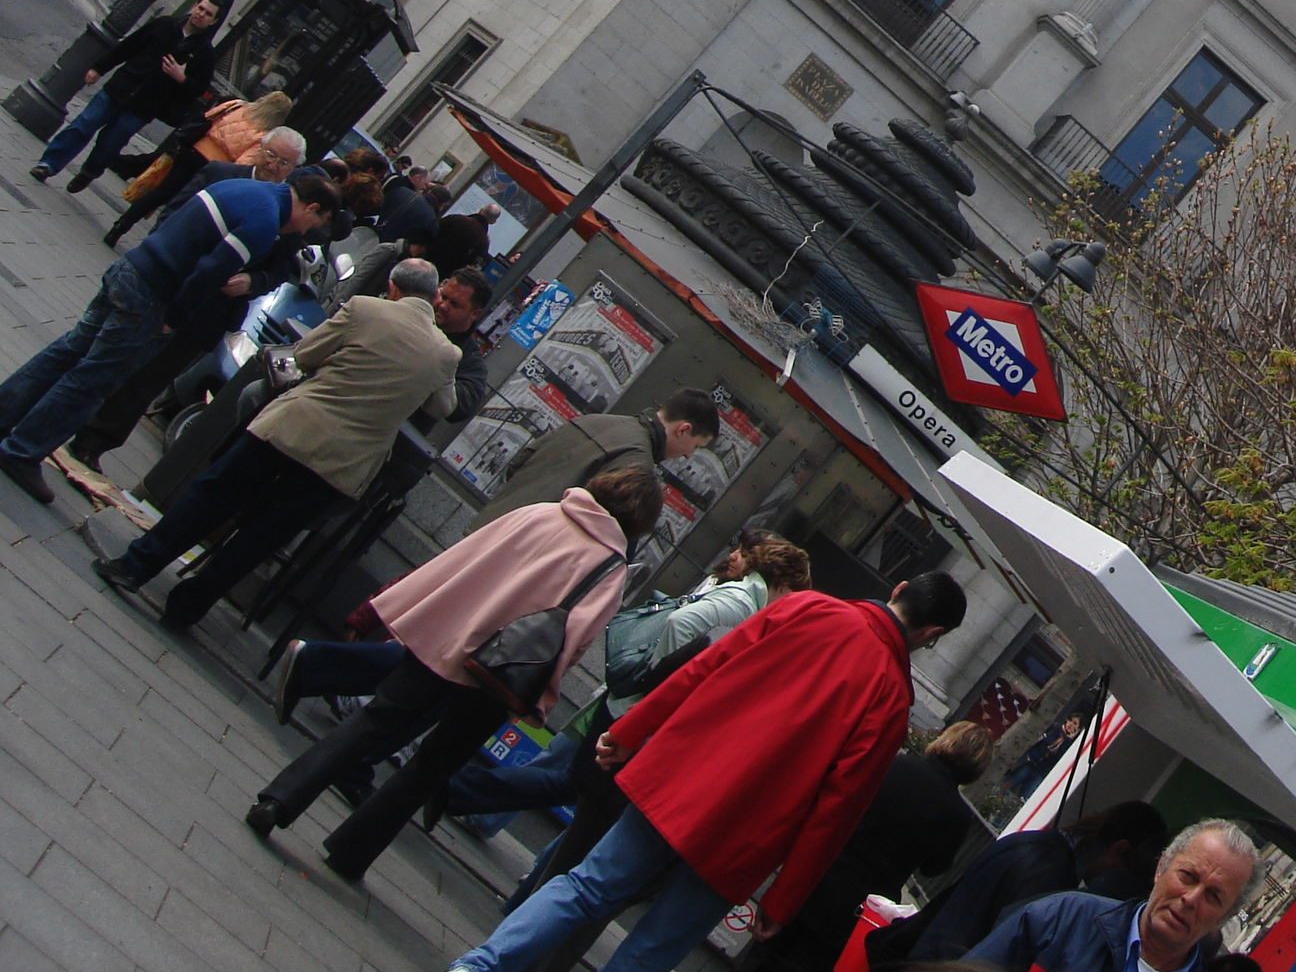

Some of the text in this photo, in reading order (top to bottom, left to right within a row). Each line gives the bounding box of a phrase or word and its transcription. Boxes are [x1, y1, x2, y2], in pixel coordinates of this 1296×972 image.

[956, 315, 1023, 384] Metro
[898, 389, 957, 448] Opera
[493, 744, 506, 757] R
[504, 732, 517, 745] 2
